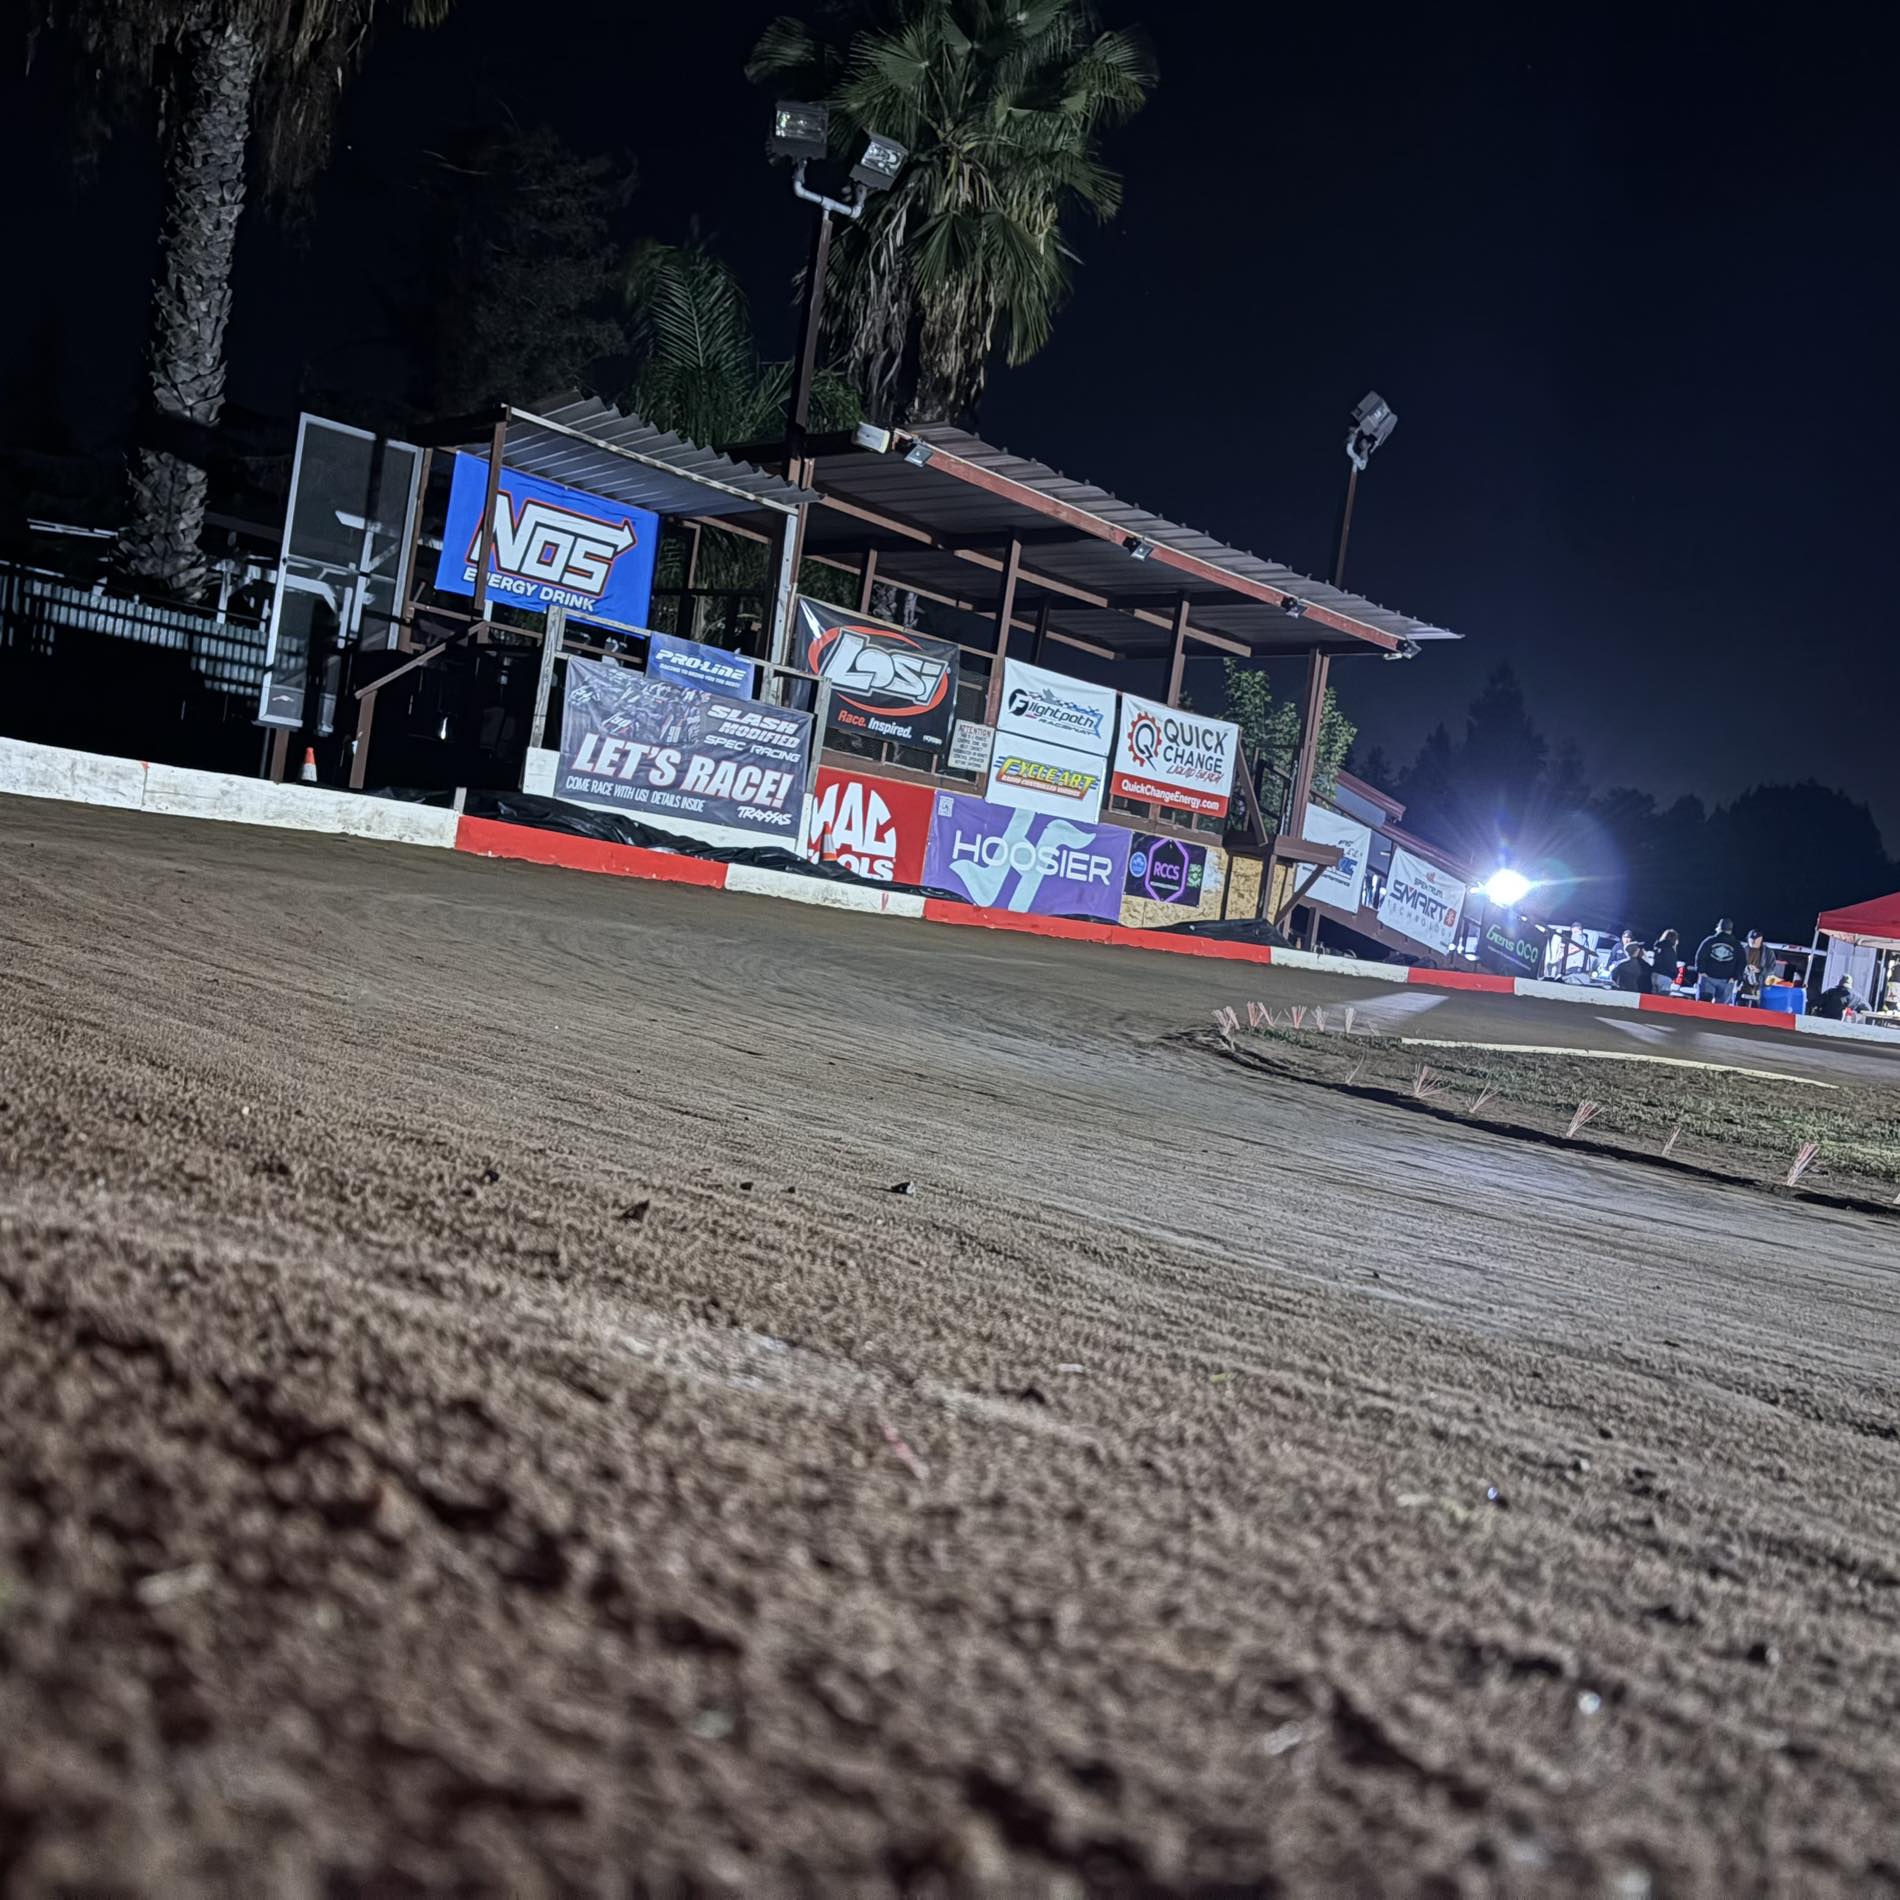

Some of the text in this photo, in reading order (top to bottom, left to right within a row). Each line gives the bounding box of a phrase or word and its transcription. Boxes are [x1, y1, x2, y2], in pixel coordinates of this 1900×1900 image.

[466, 490, 638, 598] NOS
[463, 567, 595, 612] EERGY DRINK
[707, 704, 799, 735] SLASH
[718, 721, 801, 748] MODIFIED
[838, 710, 912, 739] Race. Inspired.
[959, 725, 992, 737] ATTENTION
[704, 734, 801, 763] SPEC RACING
[1163, 718, 1228, 756] QUICK
[571, 732, 795, 808] LET'S RACE!
[1000, 756, 1058, 783] CYCLE
[1058, 767, 1097, 790] ART
[1163, 745, 1223, 774] CHANGE
[566, 775, 706, 813] COME RACE WITH US! DETAILS INSIDE
[1121, 779, 1220, 810] QuickChangeEnergy.com
[737, 805, 792, 826] TRAXXAS
[808, 781, 896, 858] MAC
[952, 830, 1112, 886] HOOSIER
[1153, 861, 1181, 880] RCCS
[1390, 879, 1448, 923] SMART
